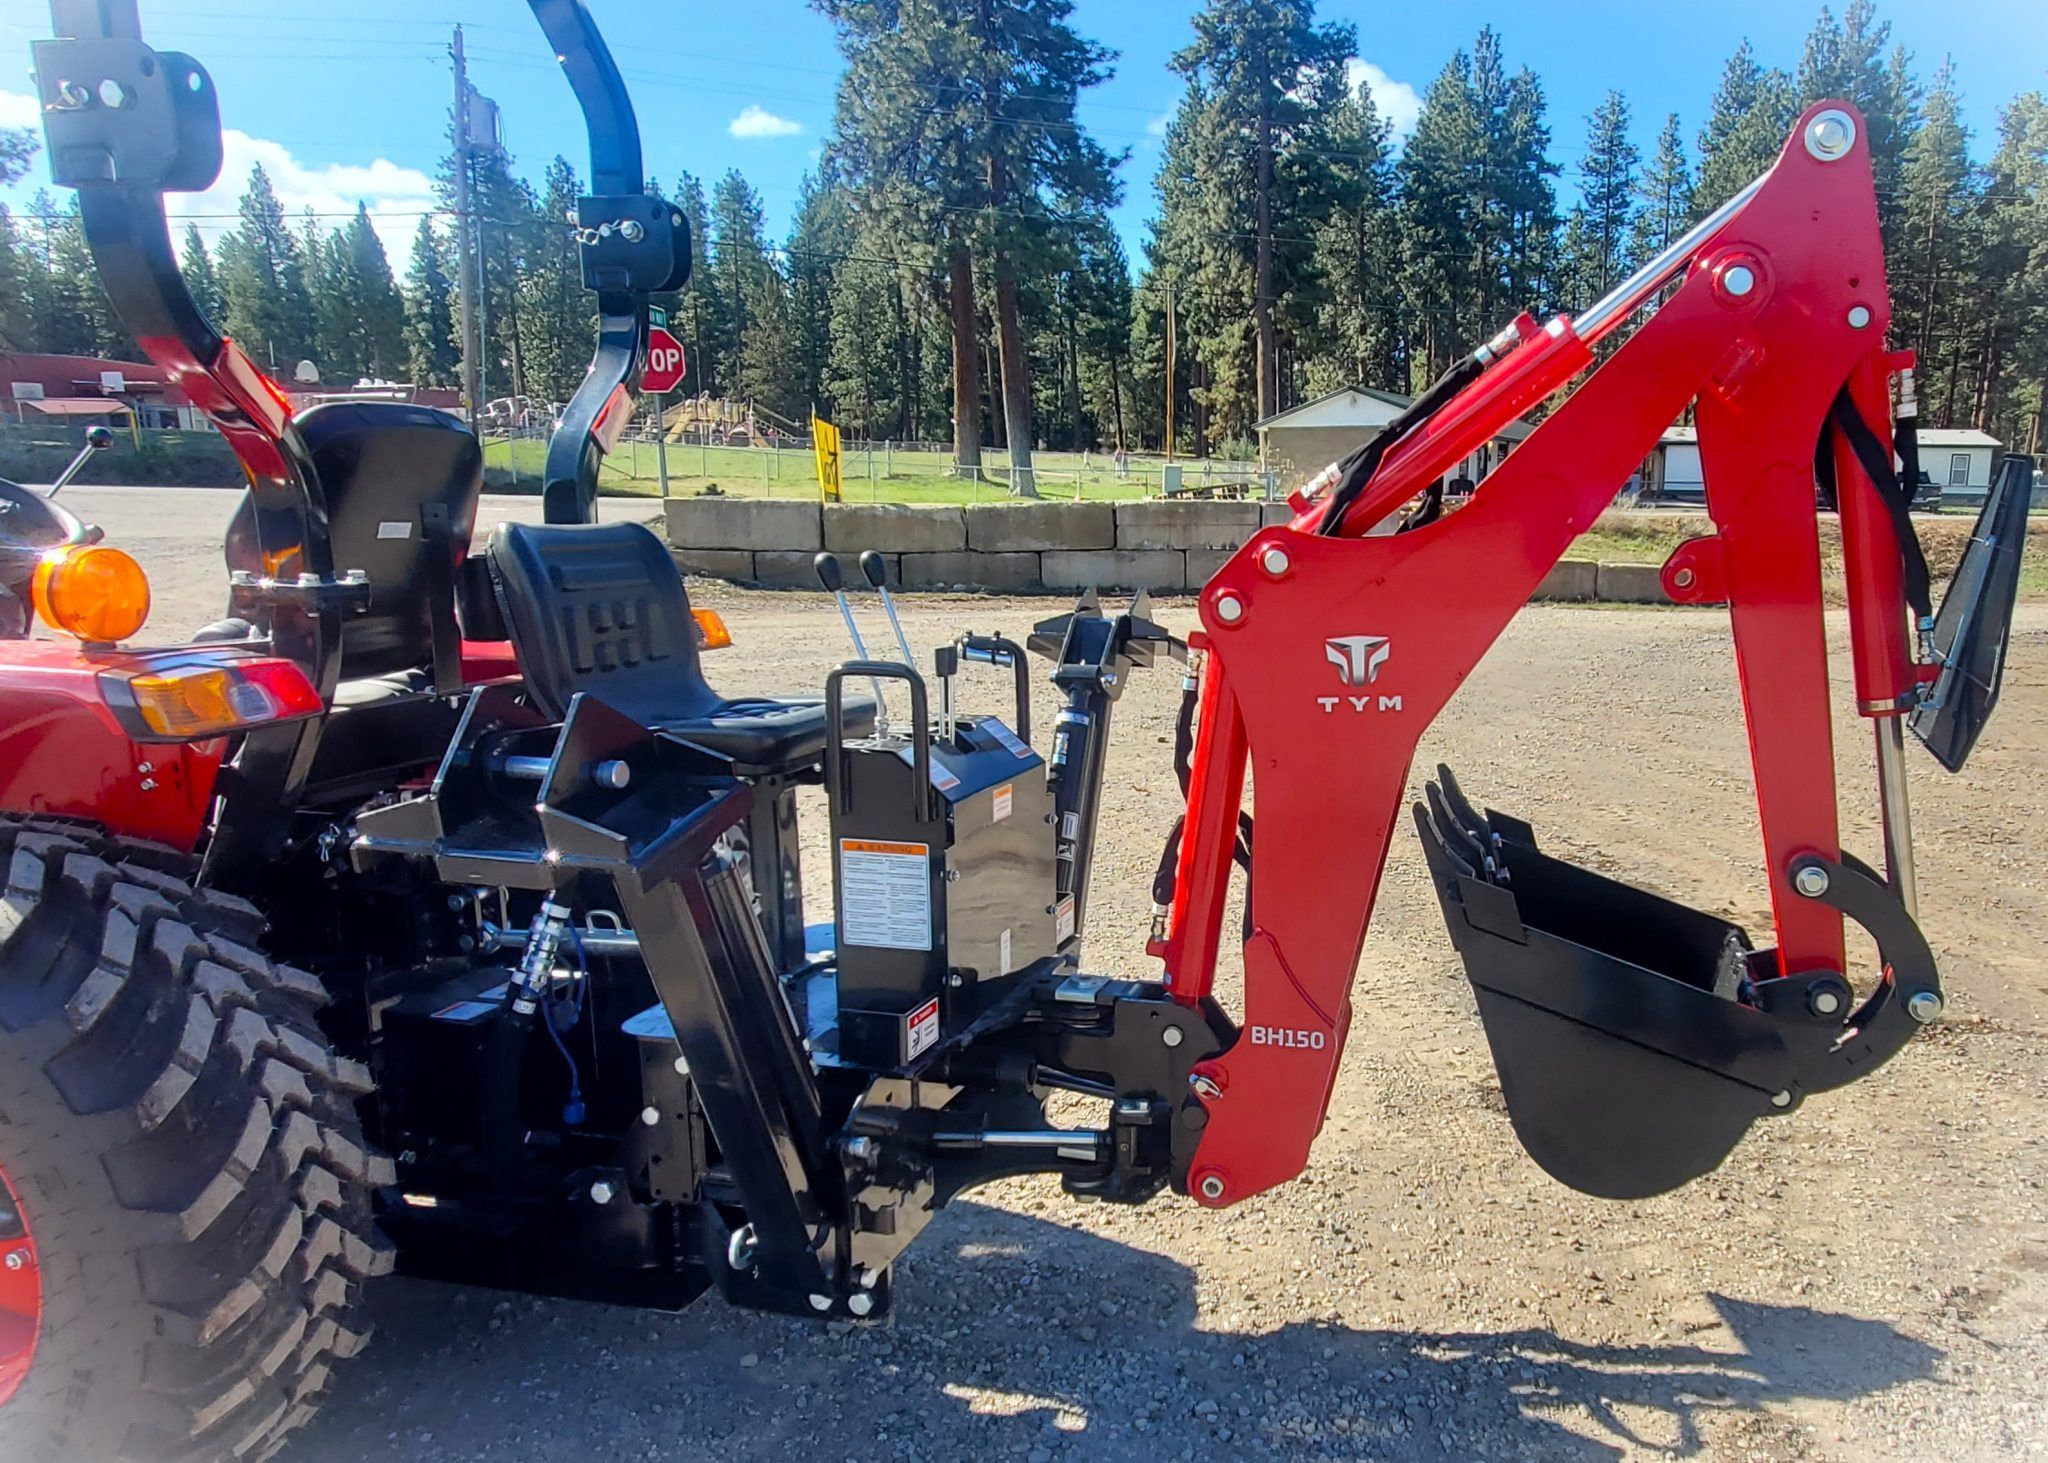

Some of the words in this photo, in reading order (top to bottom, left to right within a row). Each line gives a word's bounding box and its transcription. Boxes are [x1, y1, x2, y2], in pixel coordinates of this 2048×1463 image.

[650, 348, 680, 372] OP
[1317, 695, 1402, 712] TYM
[1251, 1026, 1325, 1049] BH150
